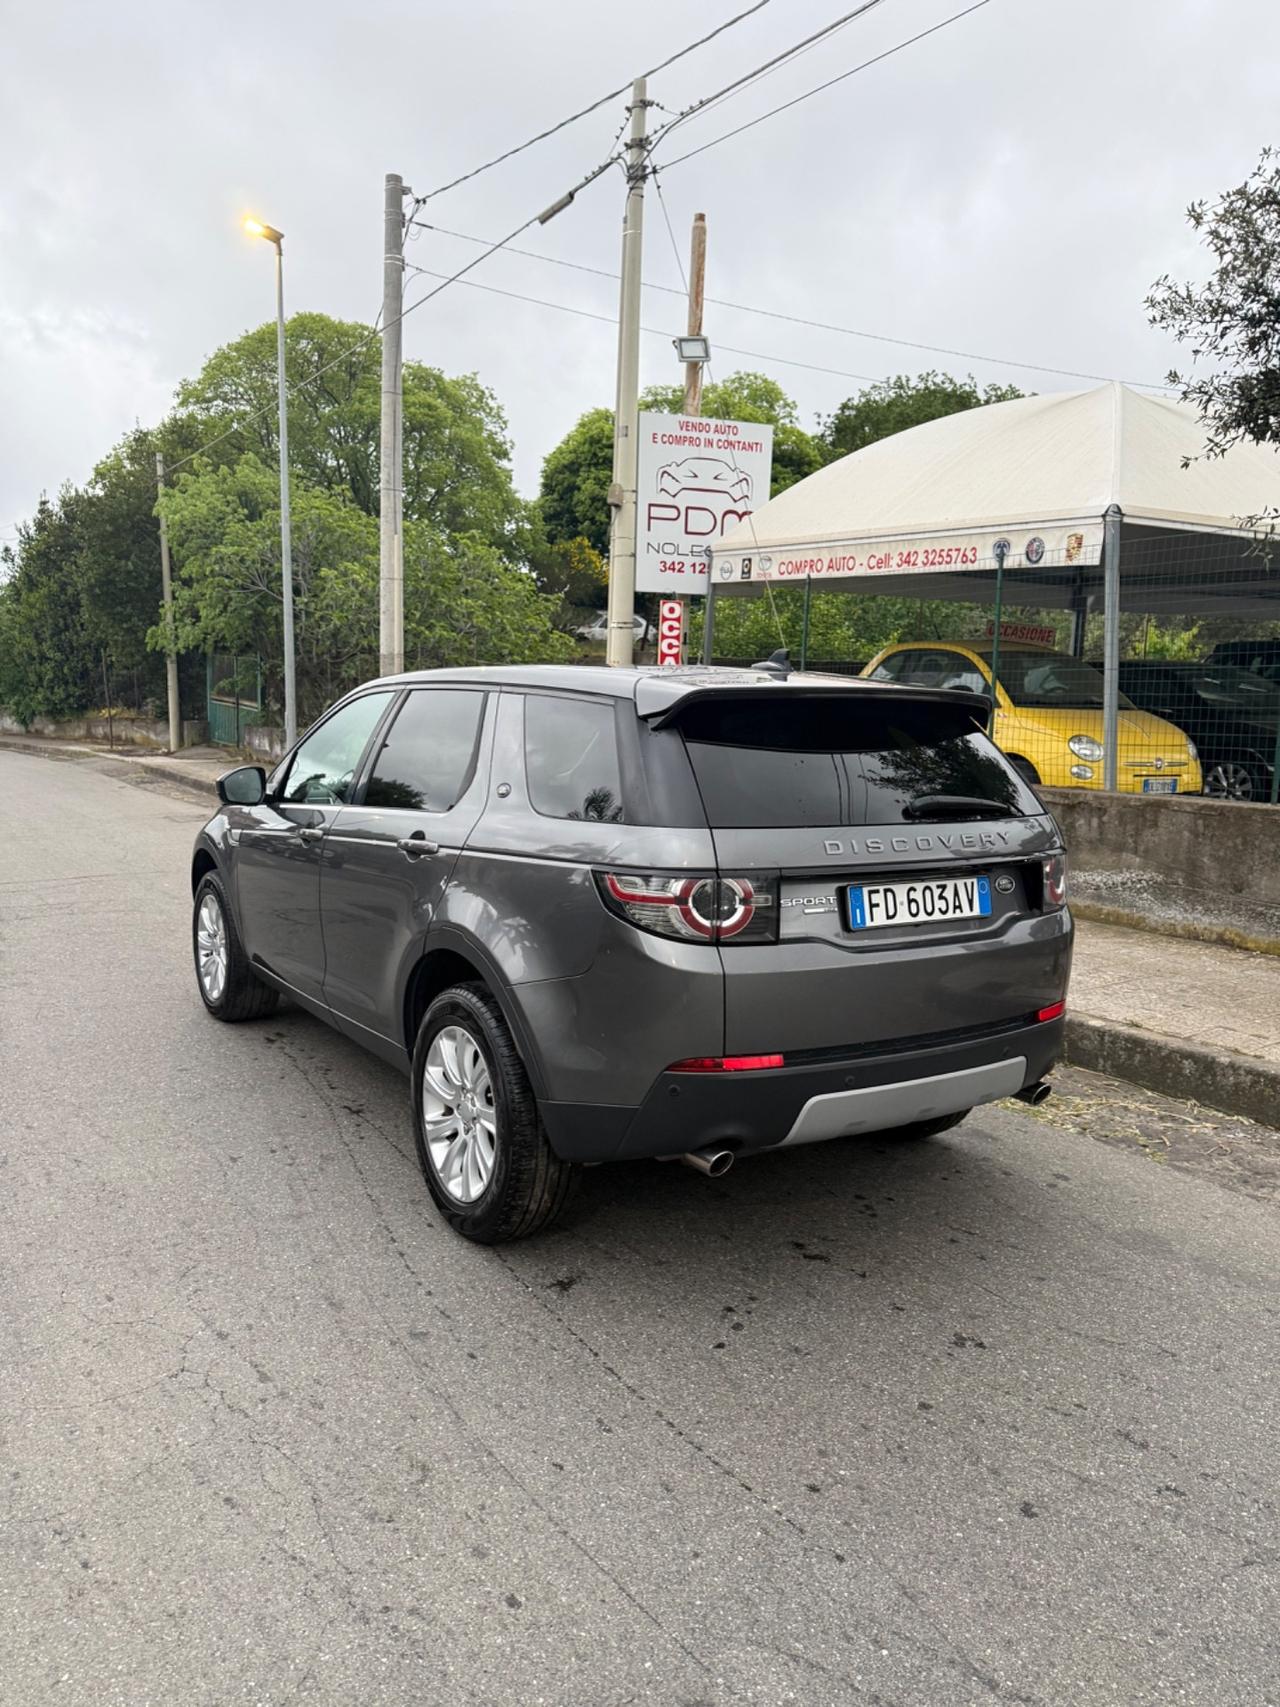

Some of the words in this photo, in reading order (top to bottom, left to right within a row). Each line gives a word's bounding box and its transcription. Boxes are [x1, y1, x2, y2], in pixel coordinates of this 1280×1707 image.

[679, 420, 711, 434] VENDO
[713, 424, 739, 436] AUTO
[652, 433, 658, 443] E
[660, 433, 701, 448] COMPRO
[703, 438, 714, 449] IN
[716, 439, 763, 453] CONTANTI
[659, 561, 685, 574] 342
[690, 562, 710, 575] 12
[778, 558, 823, 576] COMPRO
[826, 555, 856, 573] AUTO
[896, 550, 919, 568] 342
[921, 547, 977, 566] 3255763
[823, 831, 1009, 855] DISCOVERY
[780, 896, 838, 907] SPORT
